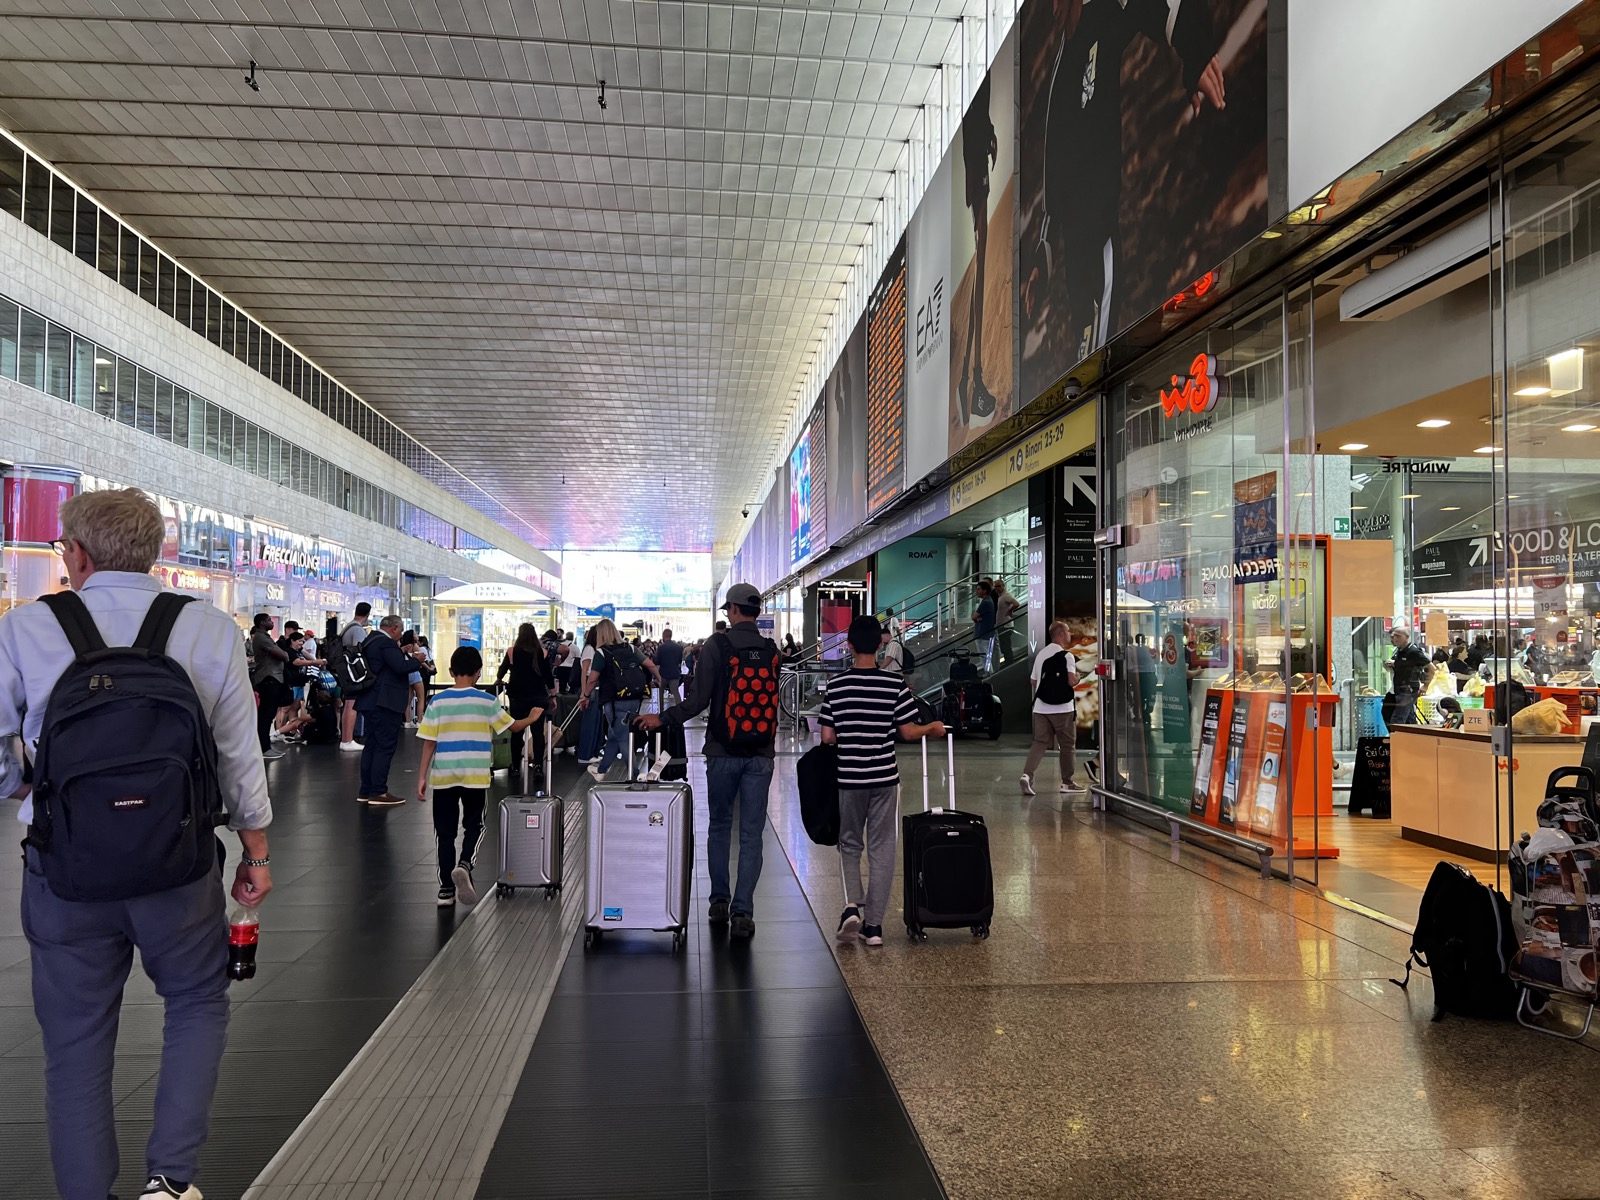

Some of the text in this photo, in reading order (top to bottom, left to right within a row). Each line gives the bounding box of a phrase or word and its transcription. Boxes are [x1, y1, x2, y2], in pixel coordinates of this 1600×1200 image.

[917, 276, 944, 357] EA7
[1025, 423, 1065, 459] Binari 25-29
[1509, 531, 1554, 554] OOD
[1558, 525, 1570, 550] &
[1425, 547, 1440, 555] PAUL
[1468, 717, 1483, 725] ZTE
[114, 799, 145, 807] EASTPAK
